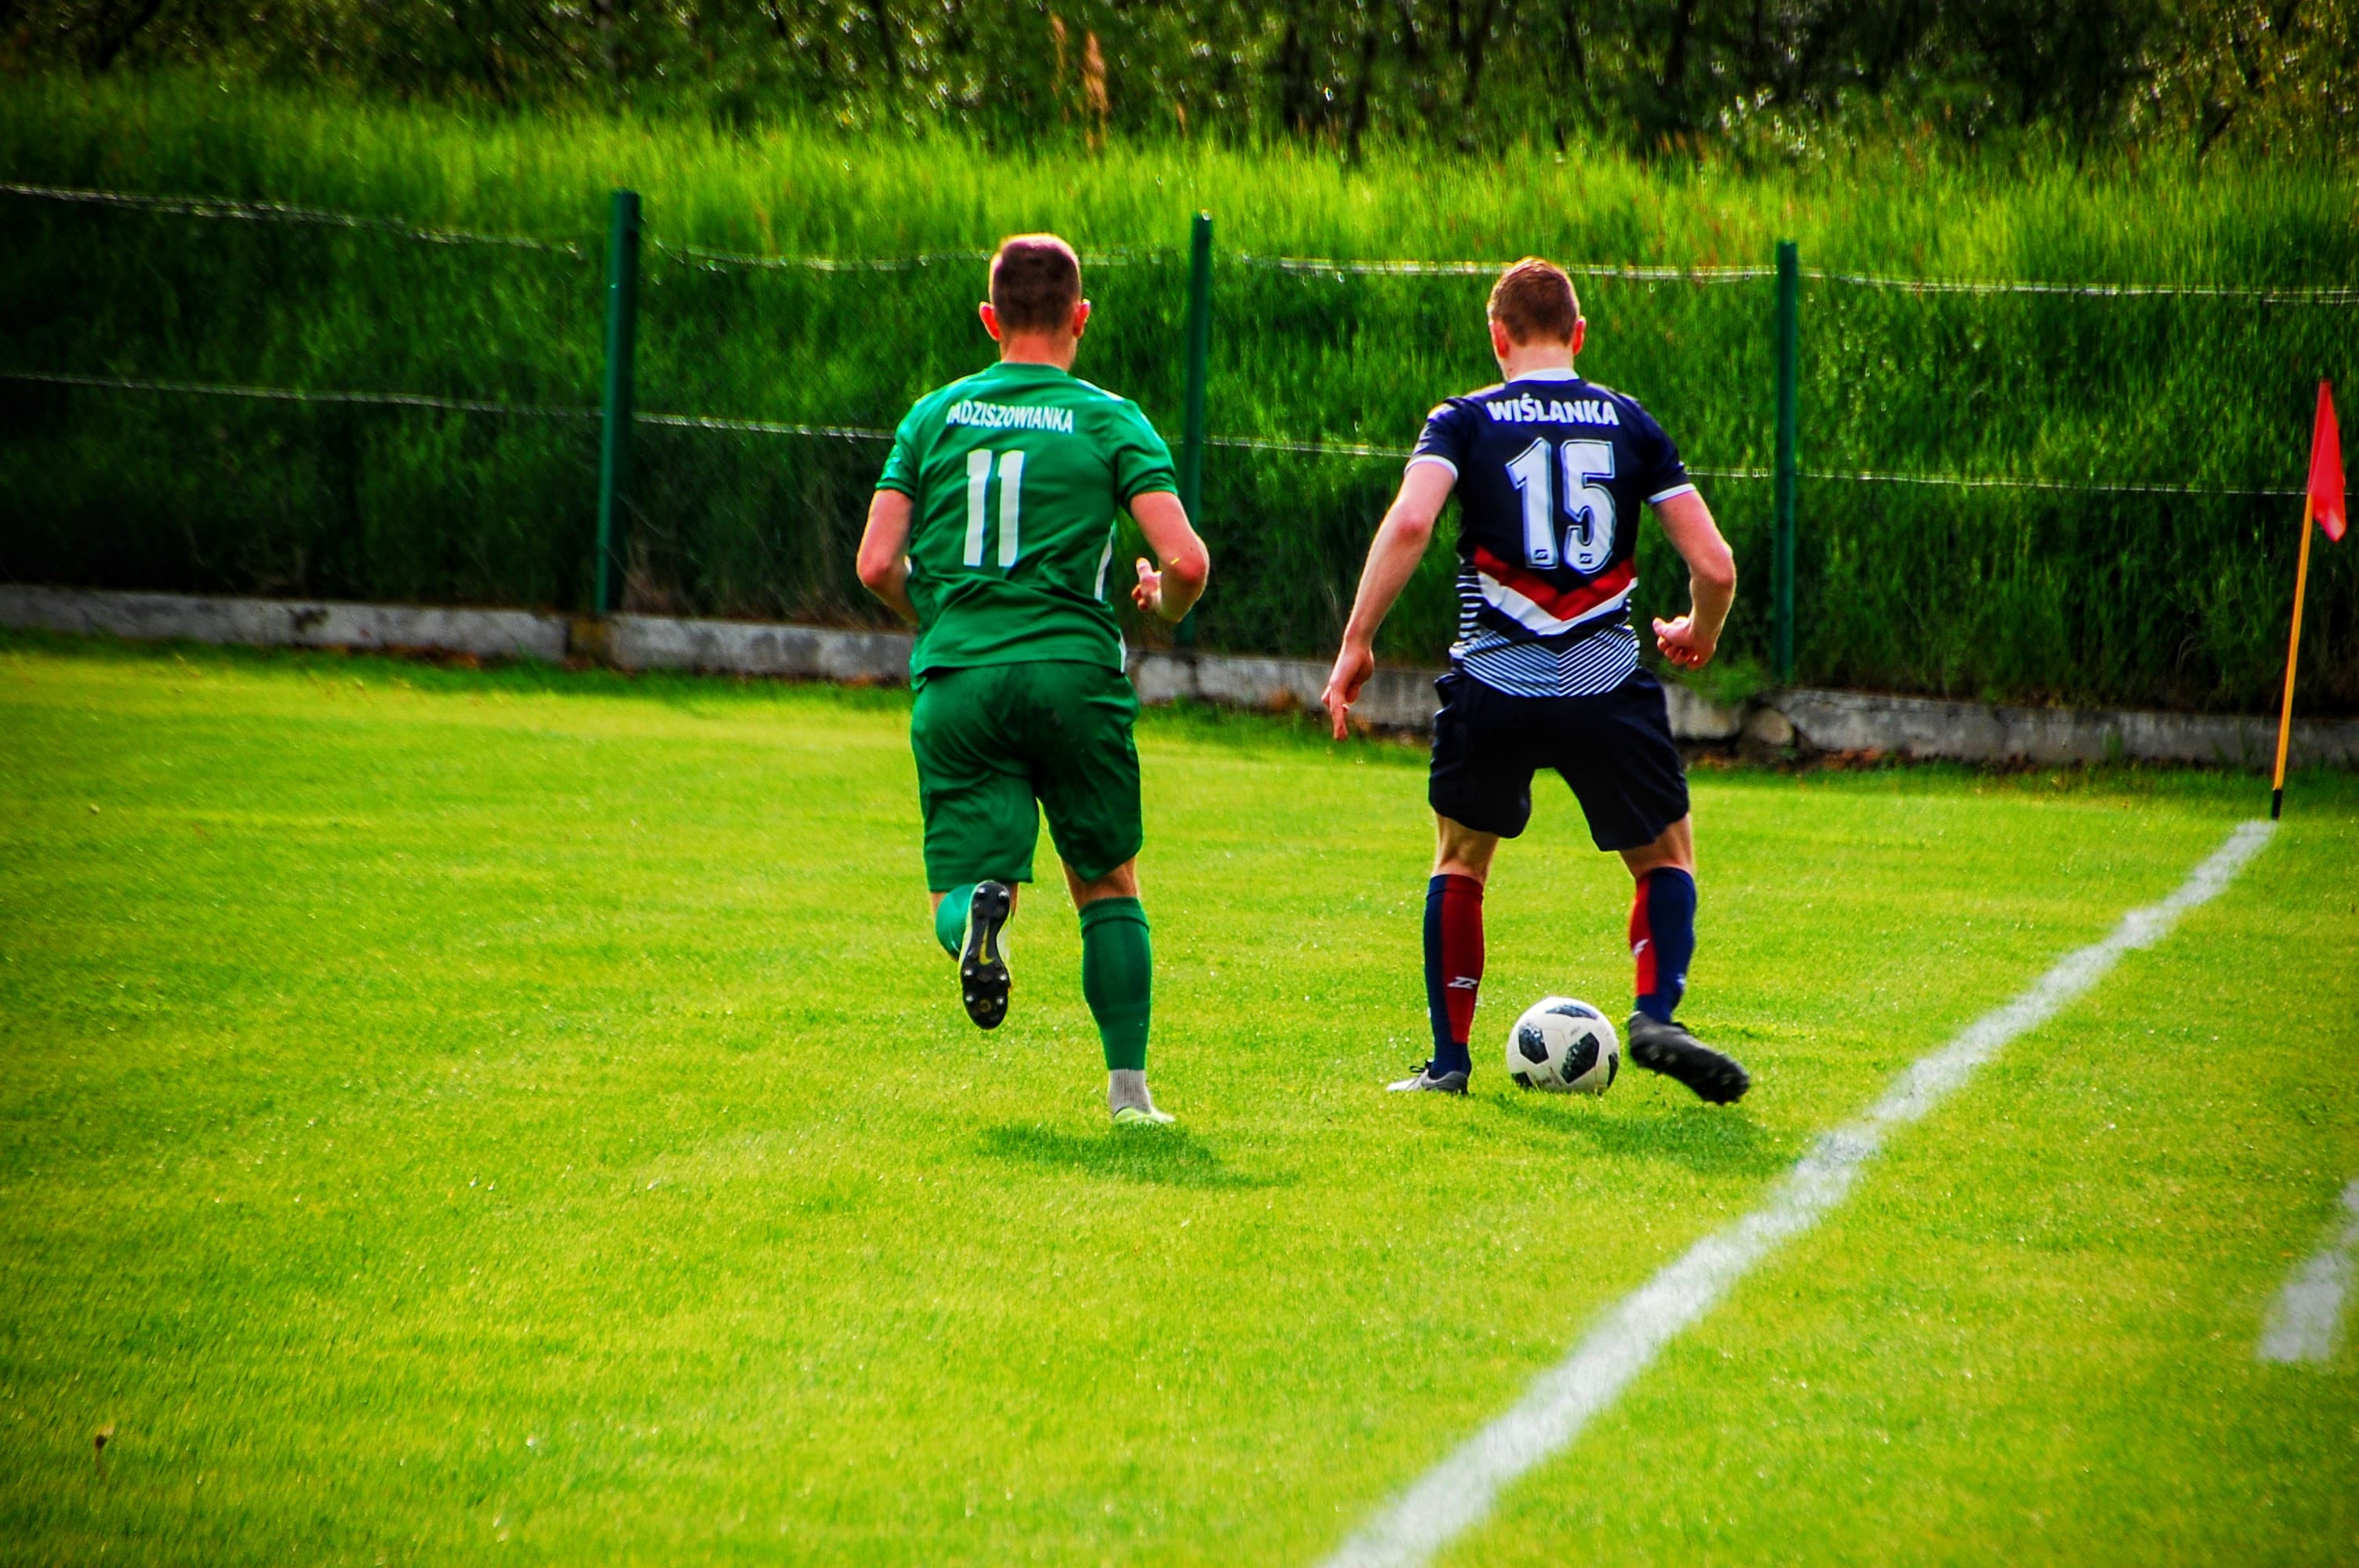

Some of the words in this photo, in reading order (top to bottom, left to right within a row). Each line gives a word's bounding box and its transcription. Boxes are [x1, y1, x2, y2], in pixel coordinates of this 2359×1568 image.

[1486, 393, 1619, 426] WIŚLANKA
[963, 448, 1025, 567] 11
[1505, 437, 1617, 574] 15
